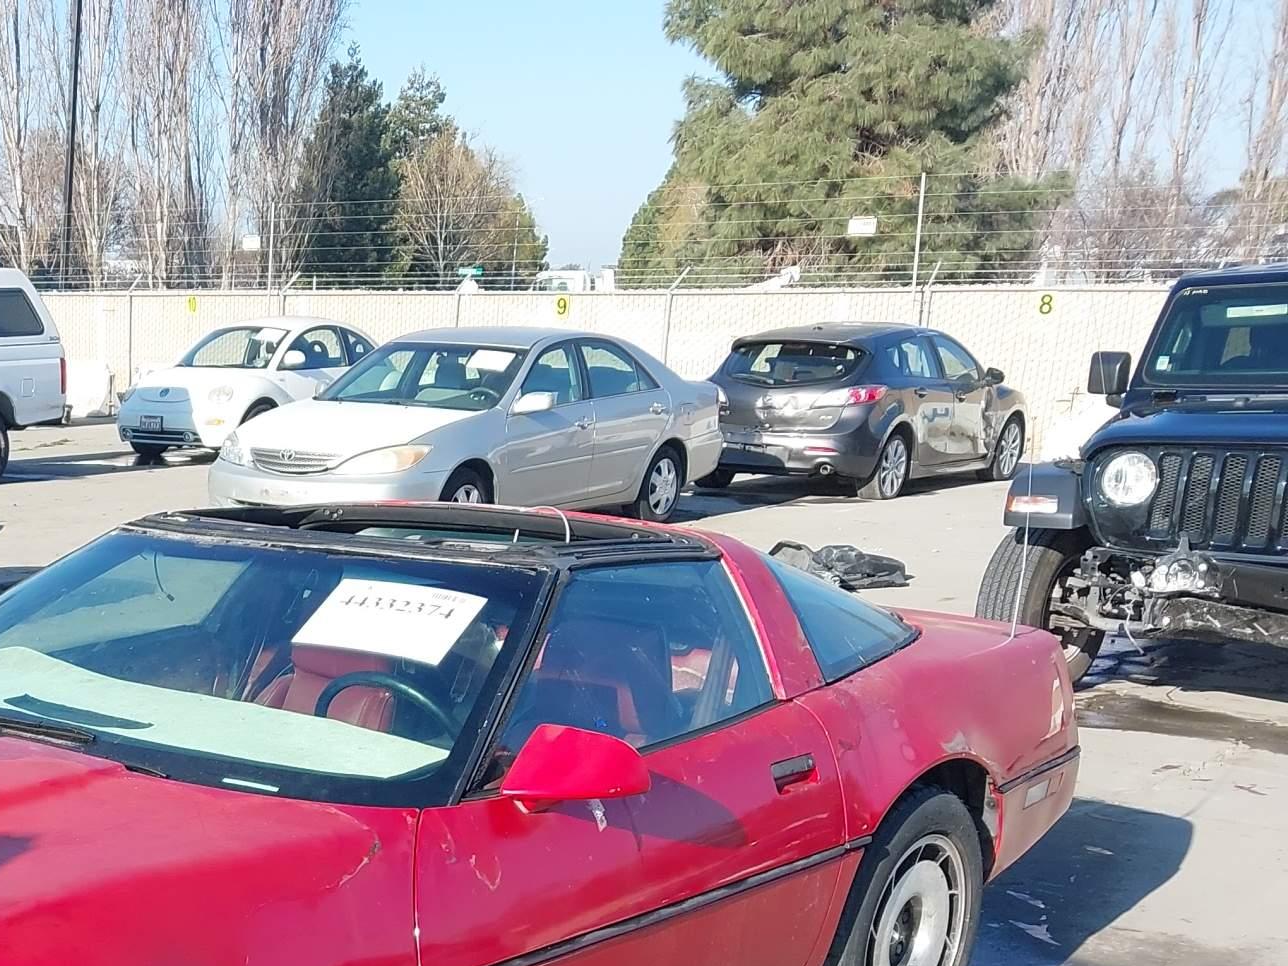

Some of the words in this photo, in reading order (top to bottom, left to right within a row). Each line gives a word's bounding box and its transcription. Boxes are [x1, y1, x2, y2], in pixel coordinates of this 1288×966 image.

[556, 297, 567, 315] 9
[1039, 294, 1053, 315] 8
[340, 595, 455, 619] 44332374
